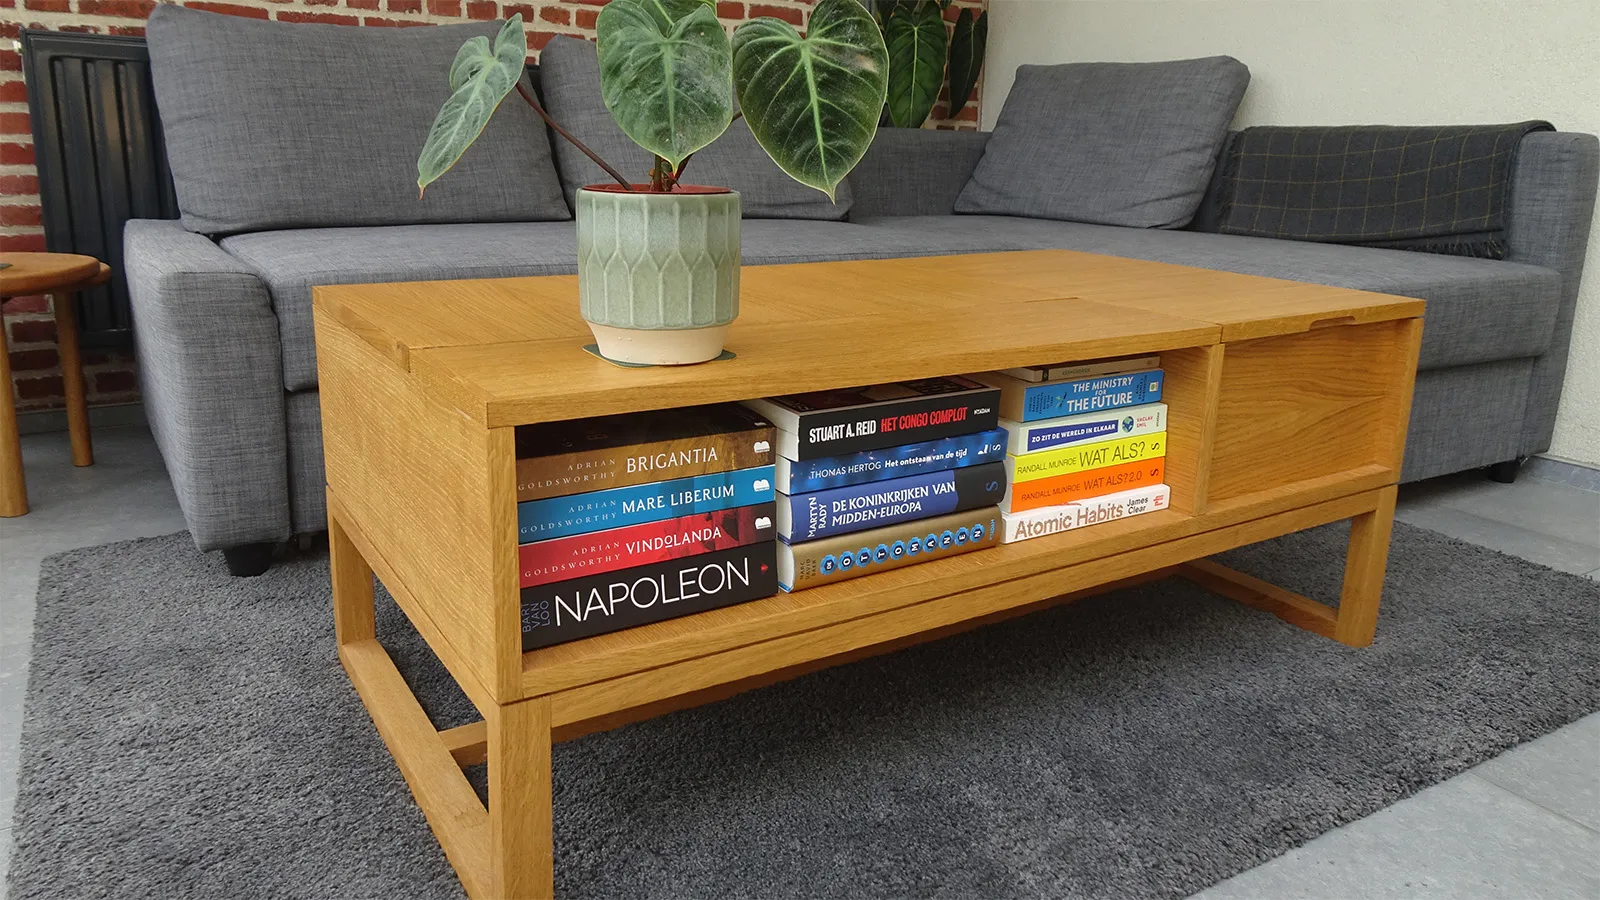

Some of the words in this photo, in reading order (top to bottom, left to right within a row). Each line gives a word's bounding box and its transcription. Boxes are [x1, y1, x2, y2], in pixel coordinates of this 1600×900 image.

[1073, 382, 1090, 393] THE
[1091, 376, 1134, 391] MINISTRY
[1067, 397, 1090, 412] THE
[1091, 391, 1133, 409] FUTURE
[809, 424, 845, 443] STUART
[846, 423, 855, 438] A.
[856, 420, 876, 436] REID
[881, 417, 898, 433] HET
[899, 411, 928, 430] CONGO
[929, 406, 968, 425] COMPLOT
[1031, 435, 1041, 443] ZO
[1041, 433, 1051, 442] ZIT
[1052, 432, 1060, 440] DE
[1061, 428, 1085, 438] WERELD
[1093, 423, 1116, 433] ELKAAR
[568, 459, 616, 471] ADRIAN
[626, 447, 718, 473] BRIGANTIA
[810, 466, 846, 480] THOMAS
[848, 461, 881, 474] HERTOG
[884, 459, 899, 468] Het
[900, 456, 931, 466] ontstaan
[945, 450, 954, 459] de
[956, 448, 968, 459] tijd
[1017, 463, 1047, 474] RANDALL
[1048, 457, 1077, 469] MUNROE
[1079, 447, 1109, 467] WAT
[1111, 441, 1146, 462] ALS?
[518, 471, 616, 491] GOLDSWORTHY
[1021, 490, 1051, 501] RANDALL
[1052, 484, 1080, 495] MUNROE
[1083, 477, 1104, 490] WAT
[569, 500, 616, 513] ADRIAN
[622, 495, 665, 514] MARE
[671, 484, 735, 506] LIBERUM
[832, 499, 847, 513] DE
[849, 486, 929, 510] KONINKRIJKEN
[932, 481, 956, 495] VAN
[1126, 496, 1149, 507] James
[1128, 505, 1146, 515] Clear
[521, 512, 617, 534] GOLDSWORTHY
[807, 496, 818, 538] MARTYN
[818, 503, 827, 529] RADY
[832, 501, 922, 527] MIDDEN-EUROPA
[1014, 512, 1072, 540] Atomic
[1077, 503, 1124, 527] Habits
[572, 542, 620, 556] ADRIAN
[625, 527, 722, 555] VINDOLANDA
[524, 553, 620, 578] GOLDSWORTHY
[554, 557, 750, 627] NAPOLEON
[530, 602, 541, 629] VAN
[539, 600, 550, 627] LOO
